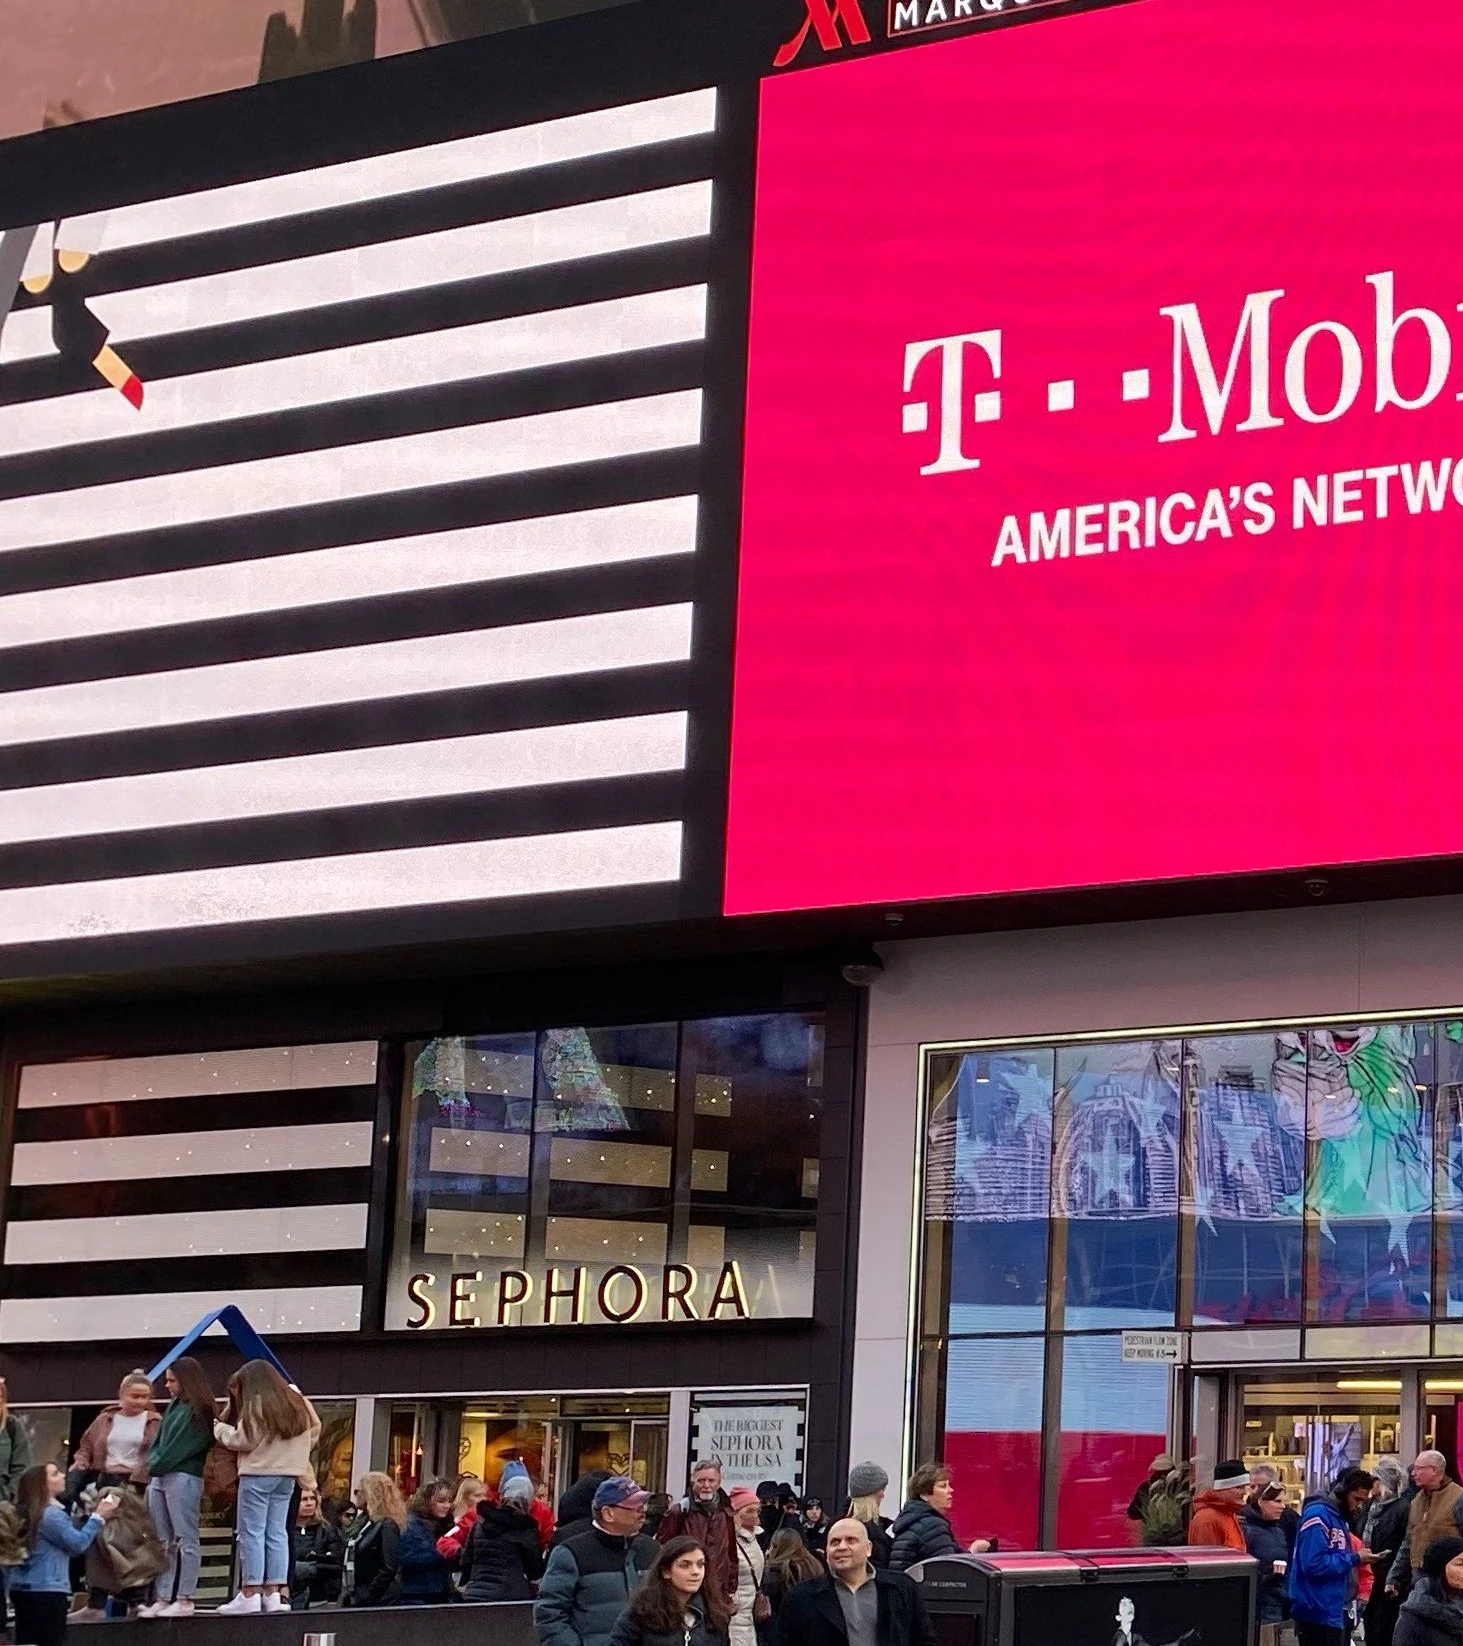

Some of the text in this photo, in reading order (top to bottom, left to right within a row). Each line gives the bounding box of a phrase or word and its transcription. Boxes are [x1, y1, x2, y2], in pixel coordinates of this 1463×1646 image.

[991, 480, 1274, 567] AMERICA'S
[406, 1260, 751, 1330] SEPHORA
[713, 1420, 784, 1432] THE BIGGEST
[711, 1434, 783, 1450] SEPHORA
[727, 1453, 753, 1467] THE
[755, 1453, 782, 1467] USA
